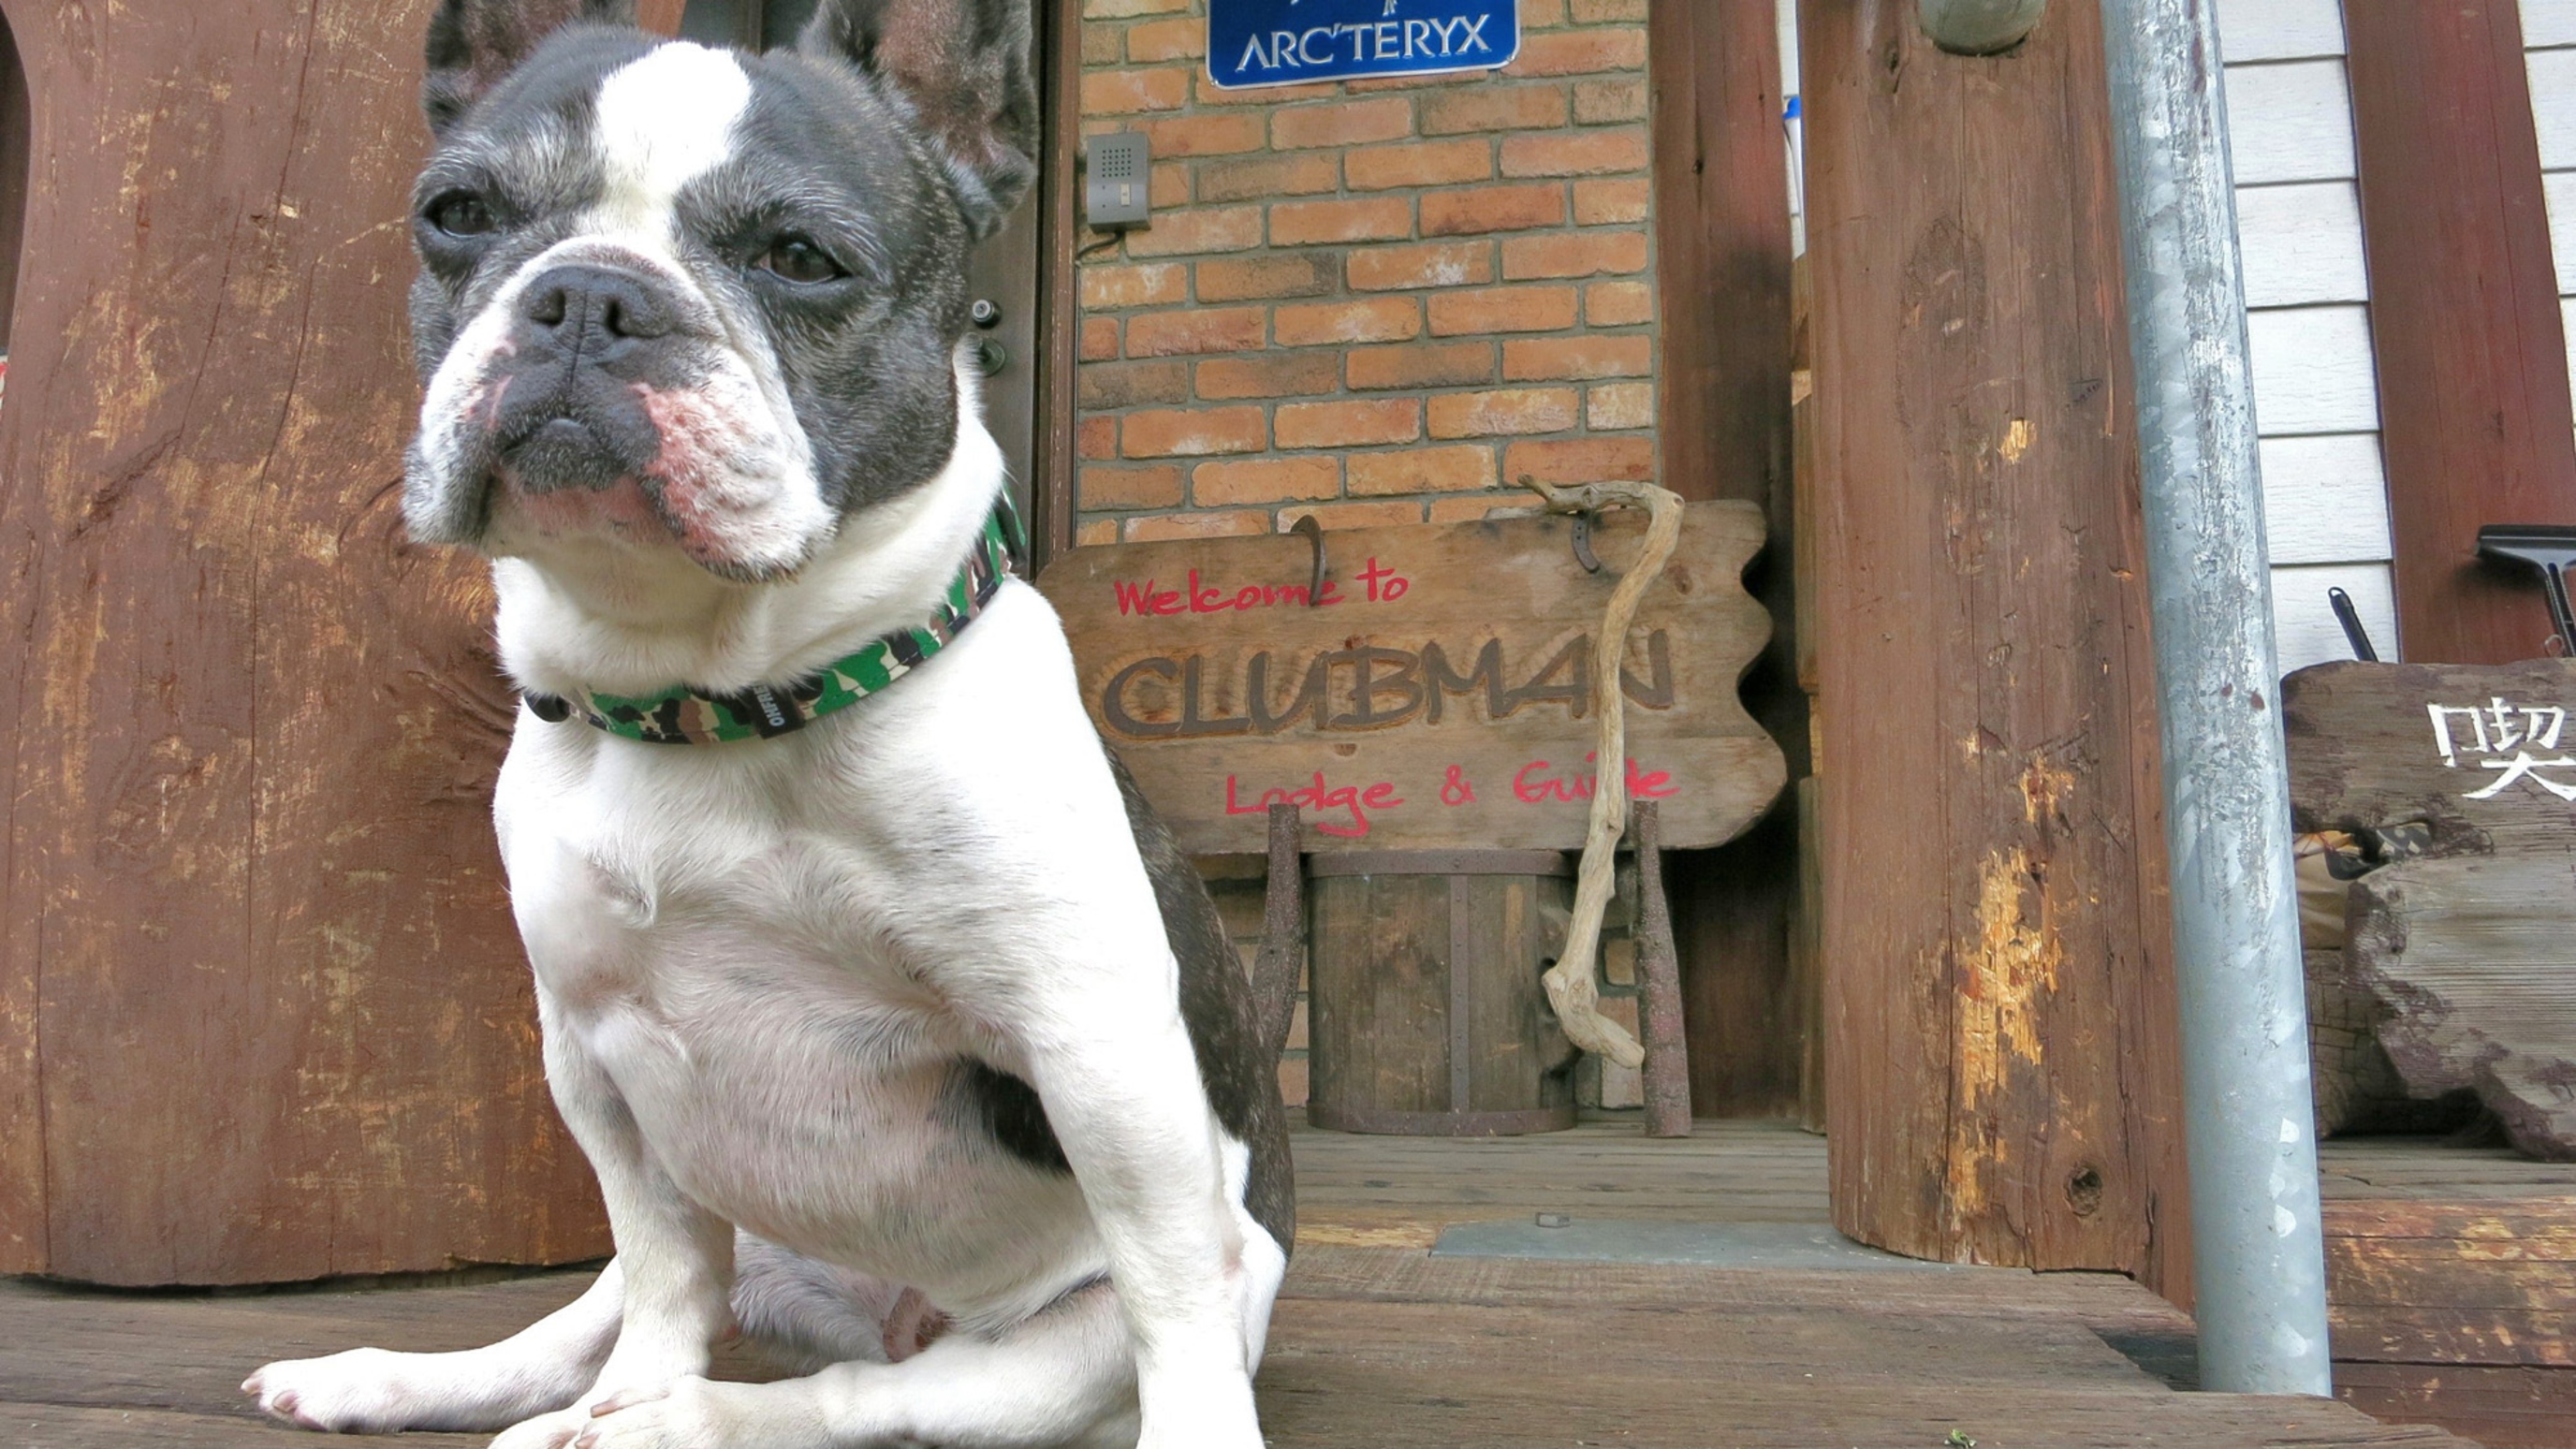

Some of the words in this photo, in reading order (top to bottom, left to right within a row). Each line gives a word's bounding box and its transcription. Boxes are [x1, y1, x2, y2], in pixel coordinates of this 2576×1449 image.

[1235, 14, 1492, 72] ARC'TERYX
[1114, 568, 1345, 617] Welcome
[1354, 557, 1410, 602] to
[1103, 628, 1675, 738] CLUBMAN
[2426, 696, 2576, 801] 喫
[1226, 771, 1404, 837] Lodge
[1440, 765, 1476, 807] &
